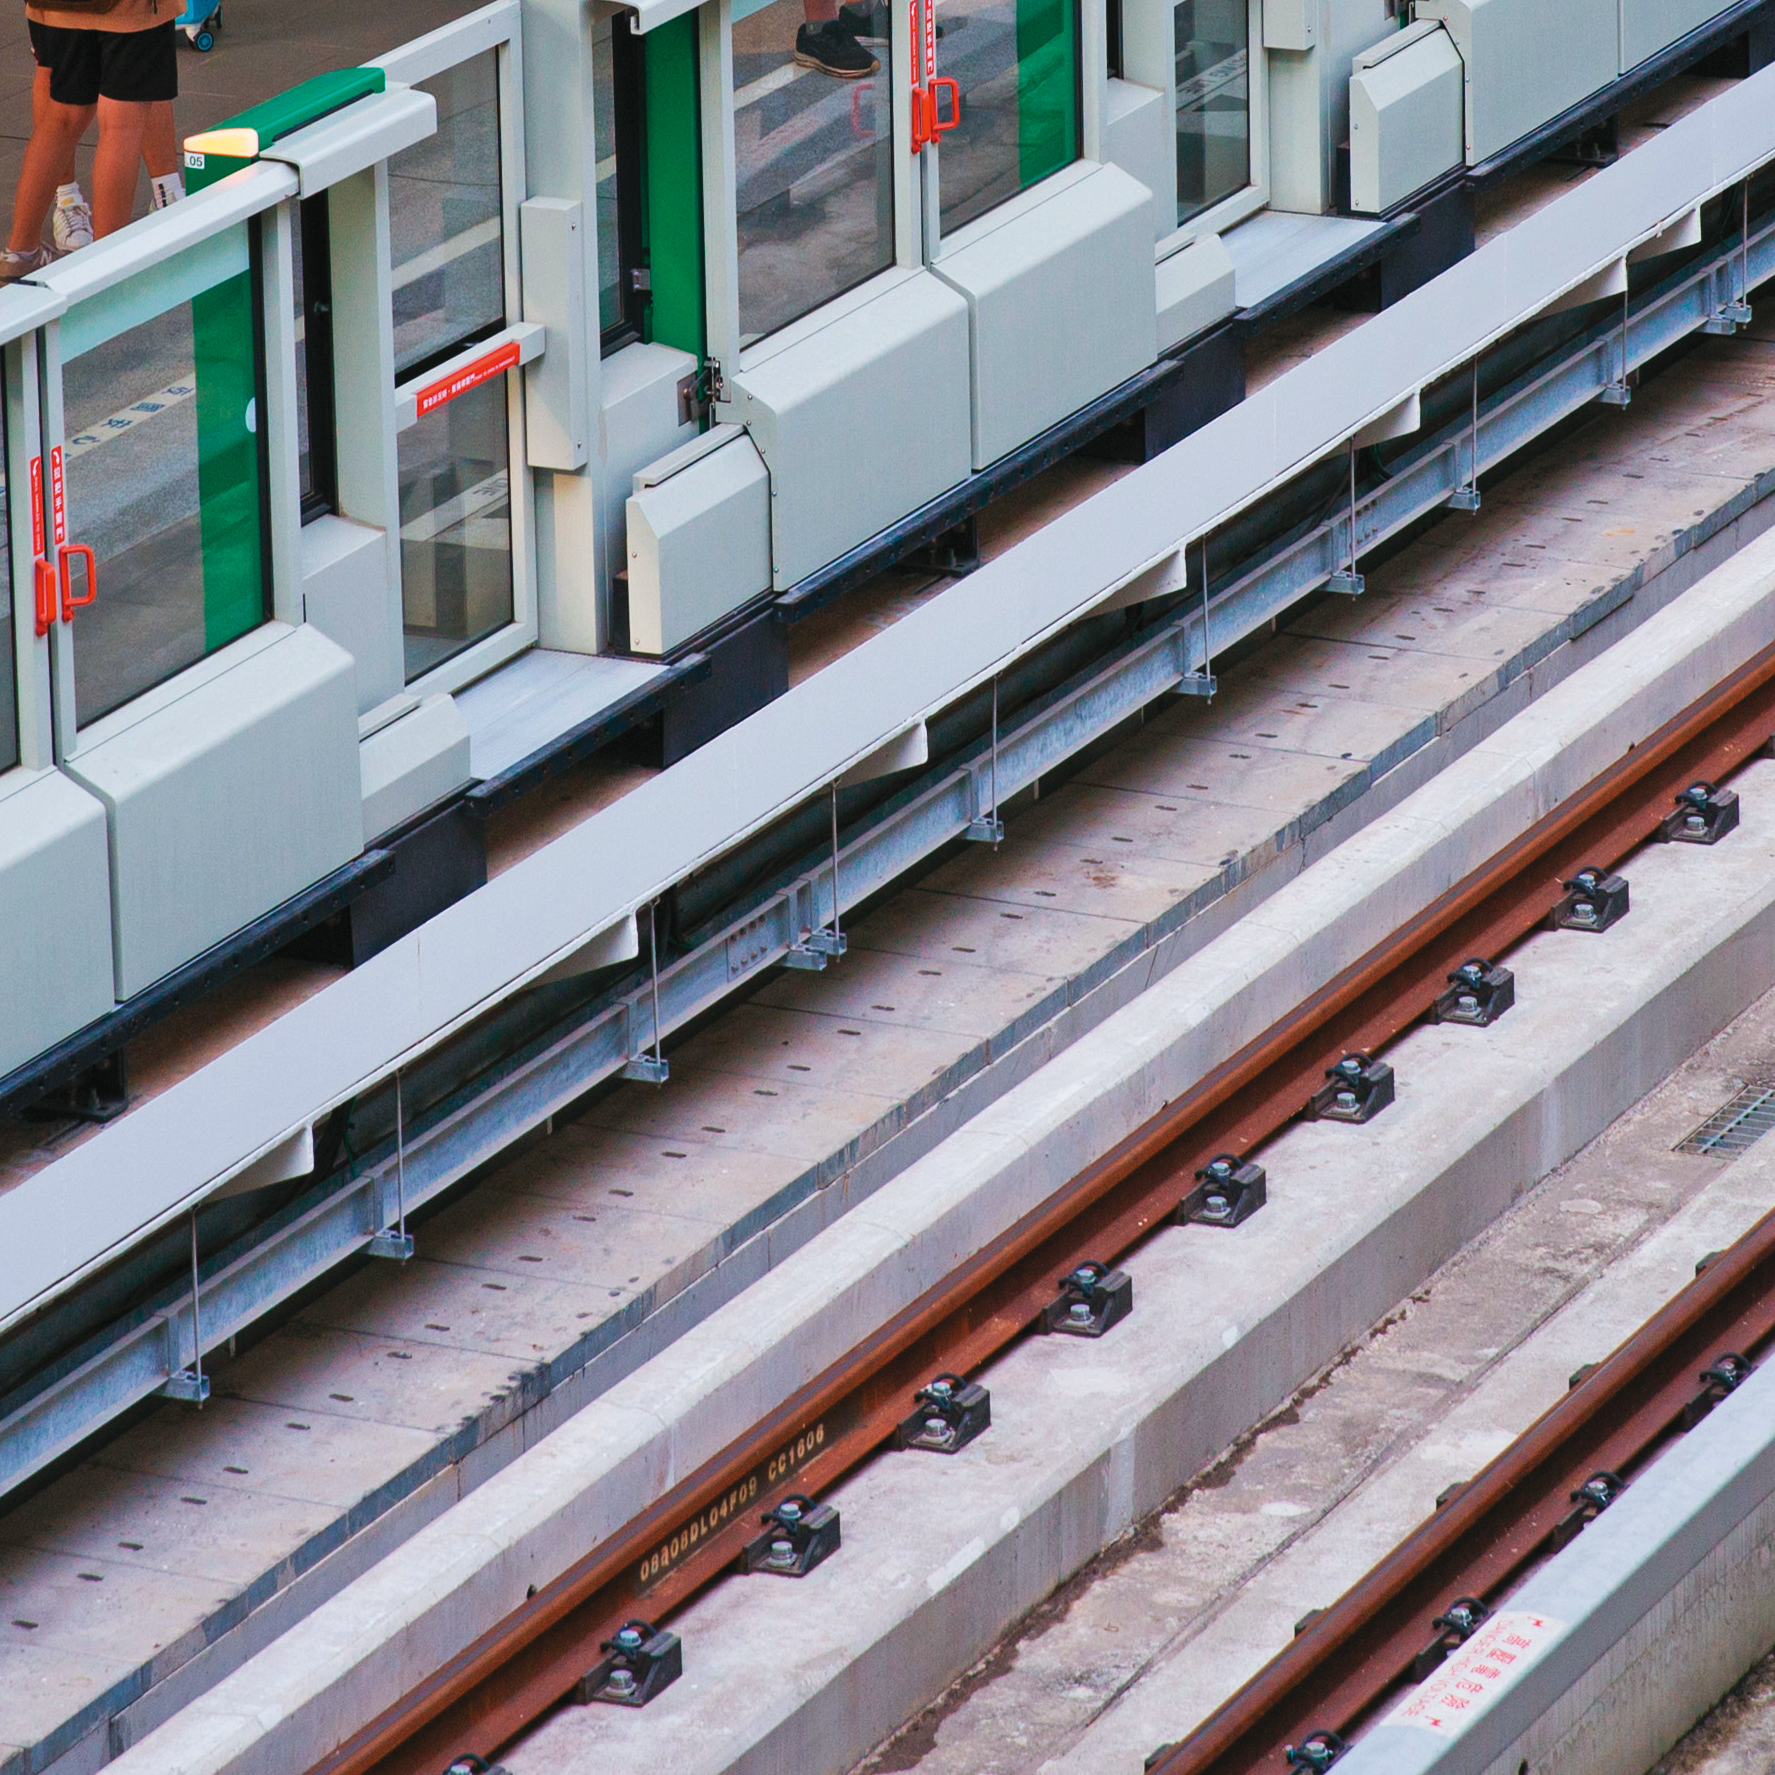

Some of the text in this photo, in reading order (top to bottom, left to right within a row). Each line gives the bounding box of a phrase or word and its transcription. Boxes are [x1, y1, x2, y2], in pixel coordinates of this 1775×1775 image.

[1440, 1632, 1533, 1710] 高壓電危險
